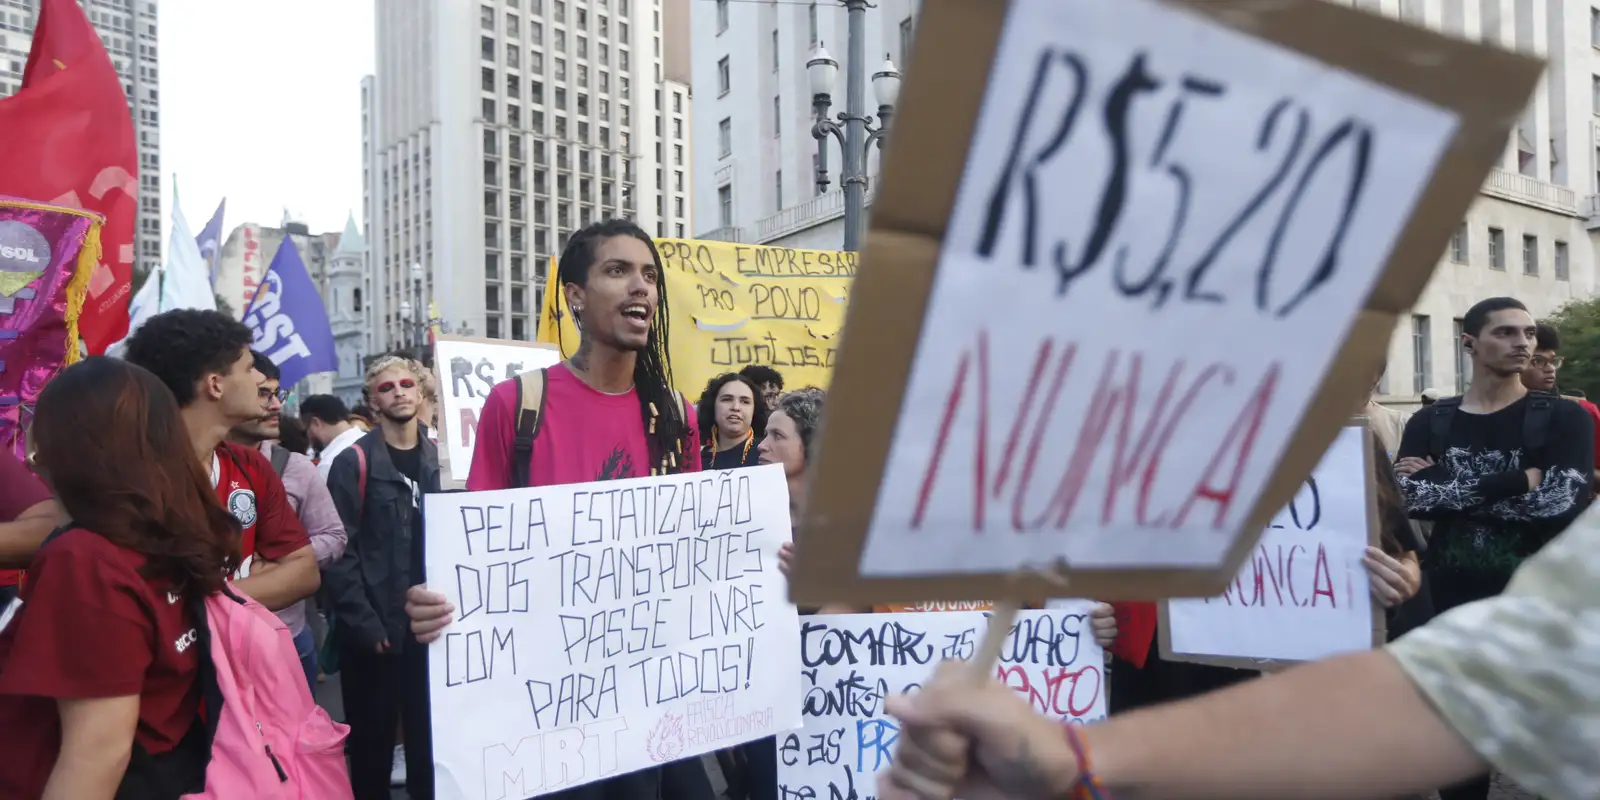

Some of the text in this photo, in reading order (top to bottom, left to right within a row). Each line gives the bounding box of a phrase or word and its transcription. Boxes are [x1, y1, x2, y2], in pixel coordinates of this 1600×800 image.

[0, 246, 39, 263] SOL
[659, 241, 715, 274] PRO
[697, 284, 735, 311] PRO
[749, 283, 821, 321] POVO
[911, 328, 1282, 533] NUNCA
[460, 470, 752, 555] PELA ESTATIZAÇÃO
[456, 528, 764, 621] DOS TRANSPORTES
[446, 585, 765, 687] COM PASSE LIVRE
[525, 637, 754, 729] PARA TODOS!
[483, 716, 629, 800] MRT
